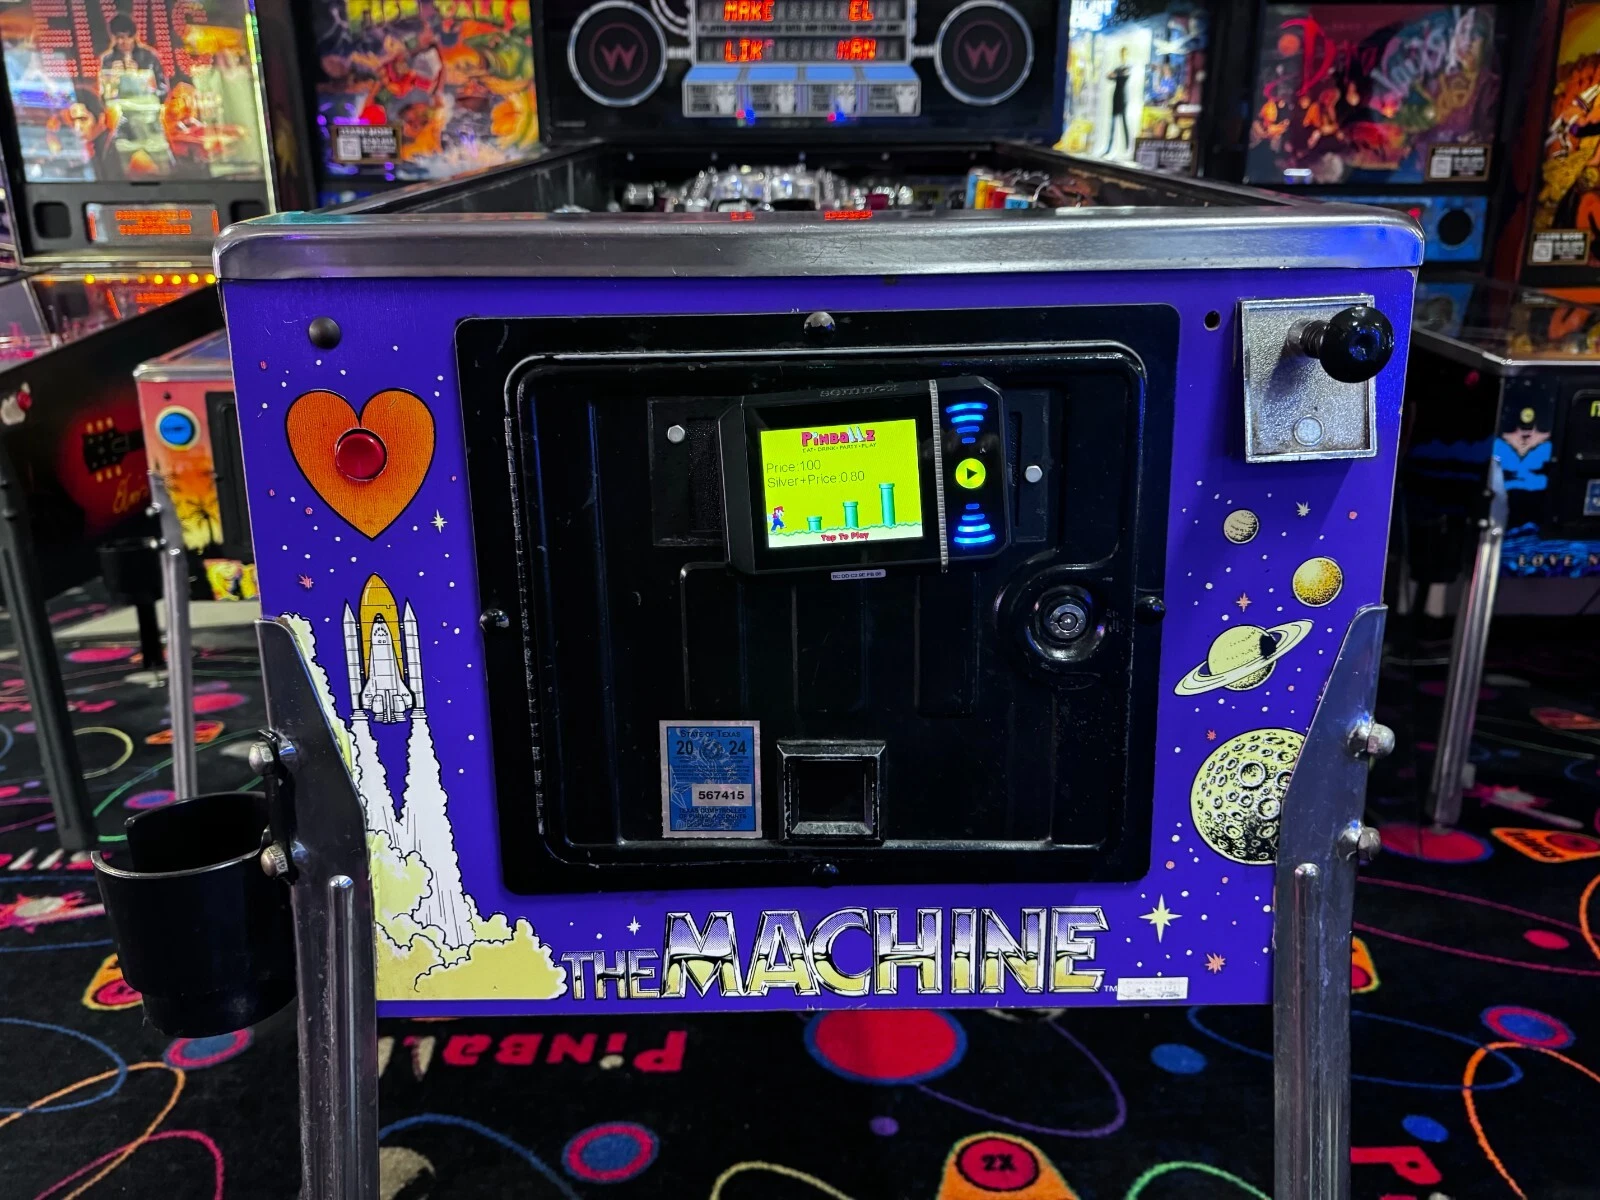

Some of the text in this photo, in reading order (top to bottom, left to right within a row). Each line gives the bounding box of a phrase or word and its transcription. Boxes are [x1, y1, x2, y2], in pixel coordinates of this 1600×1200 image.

[723, 0, 874, 21] MAKE EL
[766, 460, 821, 473] Price:100
[821, 531, 869, 542] Tap To Play
[676, 740, 747, 755] 20 24
[698, 790, 745, 800] 567415
[562, 949, 660, 999] THE
[660, 906, 1109, 998] MACHINE
